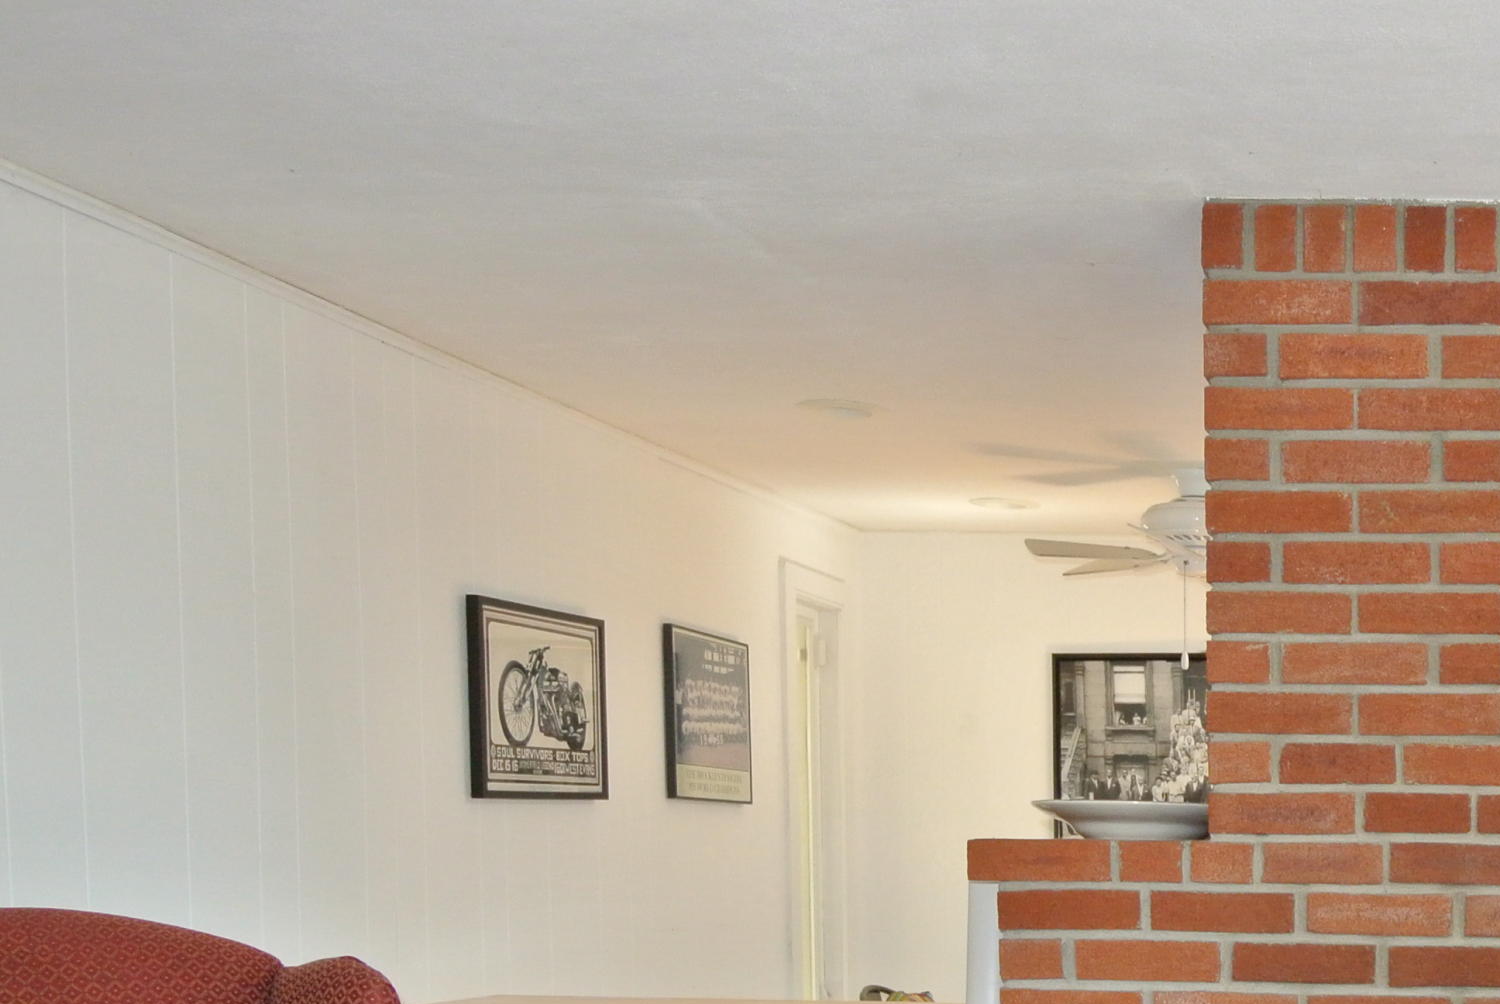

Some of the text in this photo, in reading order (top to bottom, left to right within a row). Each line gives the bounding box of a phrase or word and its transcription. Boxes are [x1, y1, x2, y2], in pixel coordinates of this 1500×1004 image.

[497, 746, 589, 763] SOUL SURVIVORS BOX TOPS
[492, 760, 504, 771] DEC
